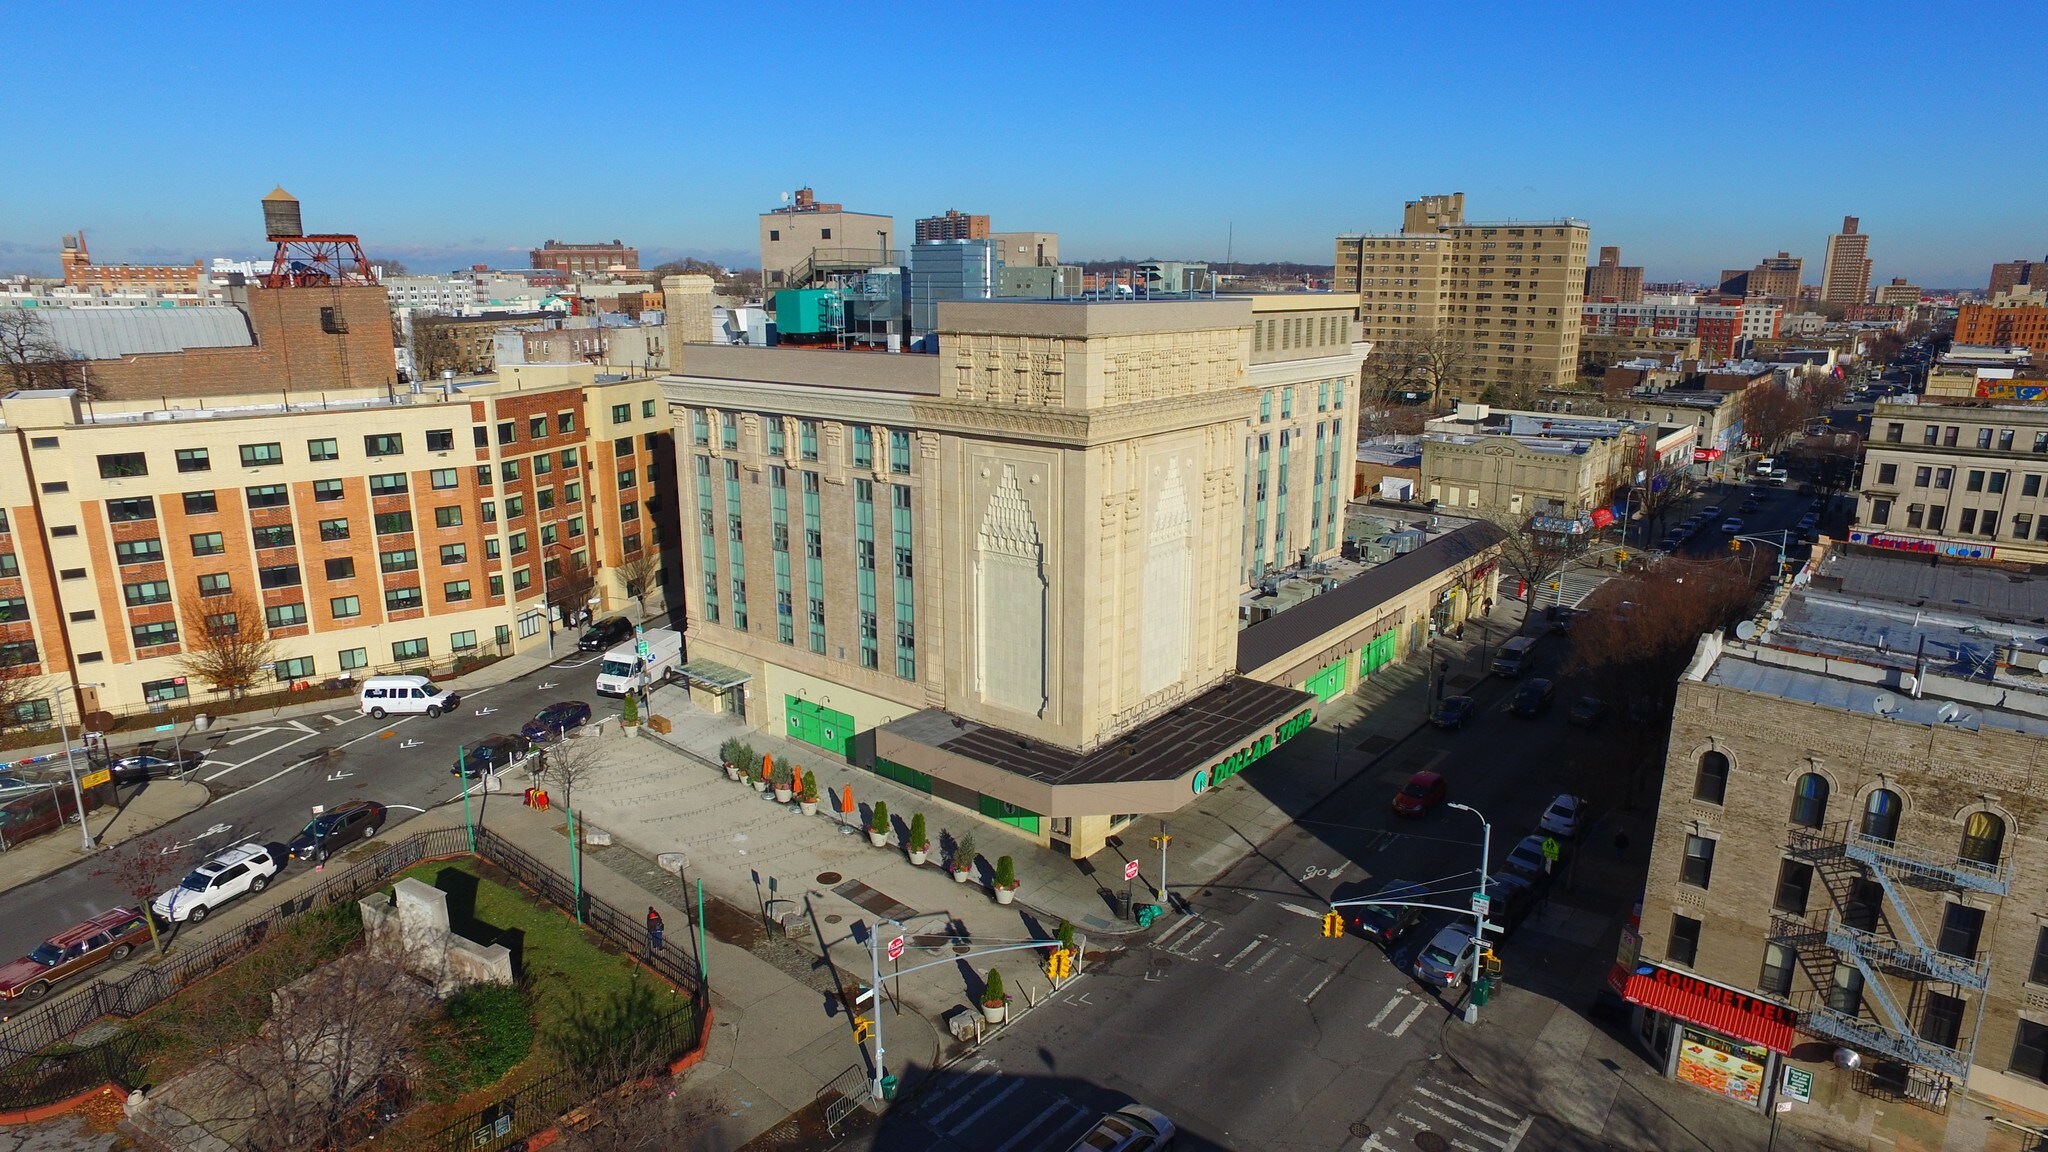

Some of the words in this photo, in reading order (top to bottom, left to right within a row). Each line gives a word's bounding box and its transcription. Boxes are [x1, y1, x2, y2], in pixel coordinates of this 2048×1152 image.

[1211, 735, 1273, 787] DOLLAR
[1276, 709, 1313, 745] TREE
[1656, 969, 1747, 1009] GOURMET
[1751, 999, 1797, 1027] DELI
